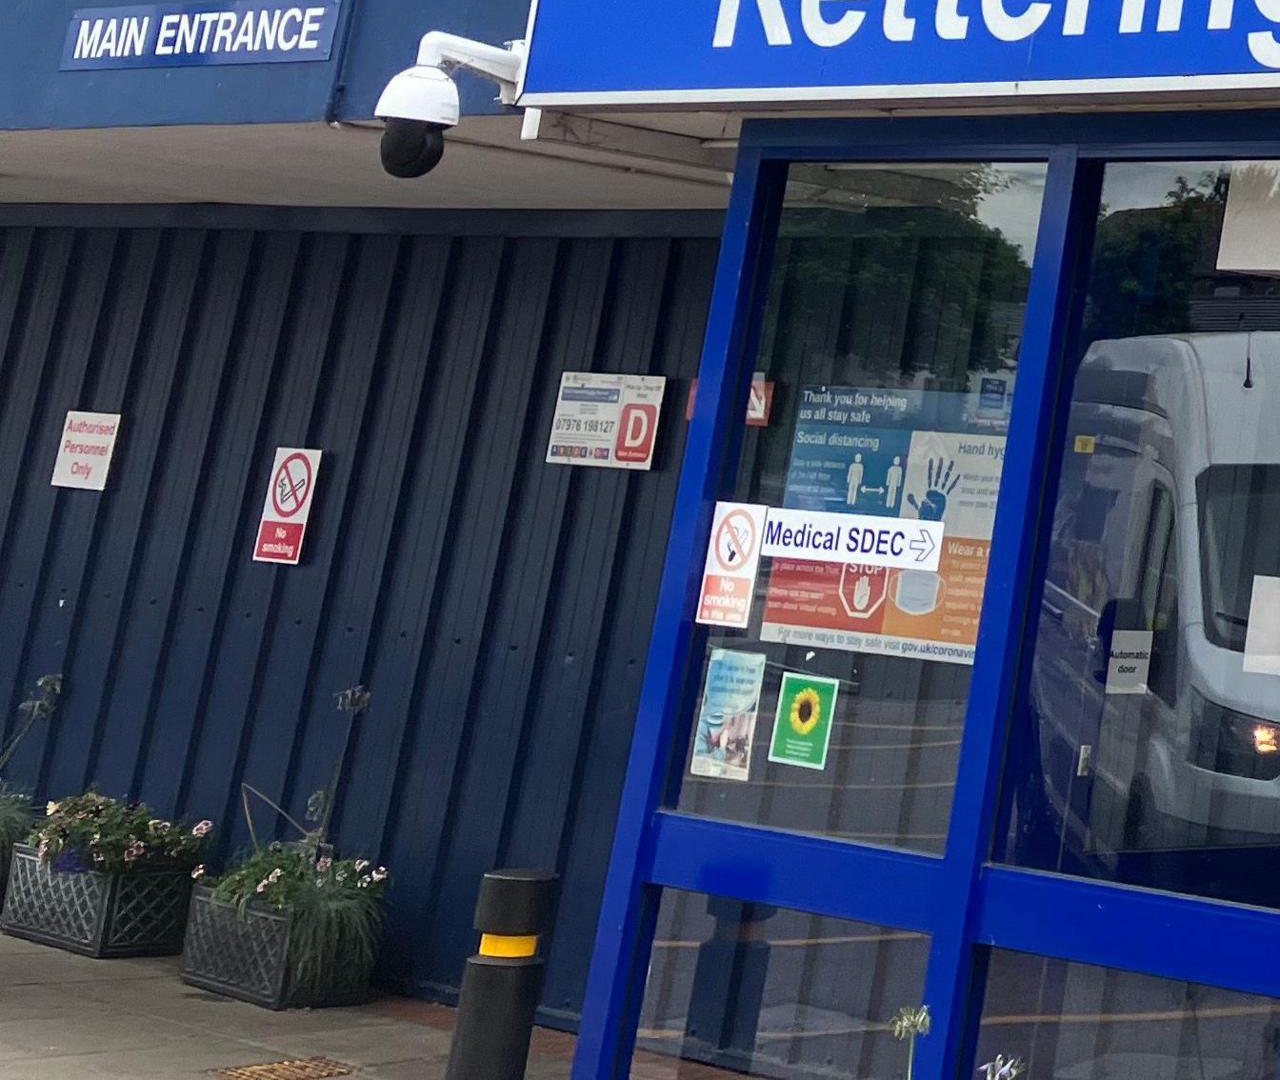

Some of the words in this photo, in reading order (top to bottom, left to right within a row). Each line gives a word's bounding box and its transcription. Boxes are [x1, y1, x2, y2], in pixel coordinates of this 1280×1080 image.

[73, 16, 150, 59] MAIN
[154, 7, 325, 56] ENTRANCE
[803, 390, 831, 404] Thank
[834, 394, 853, 408] you
[855, 393, 868, 406] for
[870, 394, 908, 411] helping
[800, 410, 811, 420] us
[813, 408, 825, 420] all
[828, 410, 848, 424] stay
[850, 410, 871, 423] safe
[66, 419, 116, 435] Authorised
[625, 408, 648, 448] D
[64, 439, 109, 456] Personnel
[797, 431, 827, 445] Social
[828, 432, 880, 452] distancing
[958, 442, 986, 455] Hand
[71, 462, 92, 480] Only
[274, 527, 288, 540] No
[765, 520, 841, 552] Medical
[846, 527, 905, 557] SDEC
[262, 543, 295, 558] smoking
[948, 541, 975, 557] Wear
[976, 546, 984, 557] a
[719, 578, 735, 593] No
[703, 594, 747, 612] smoking
[814, 631, 836, 646] ways
[836, 633, 846, 644] to
[1109, 650, 1149, 660] Automatic
[1117, 665, 1137, 674] door
